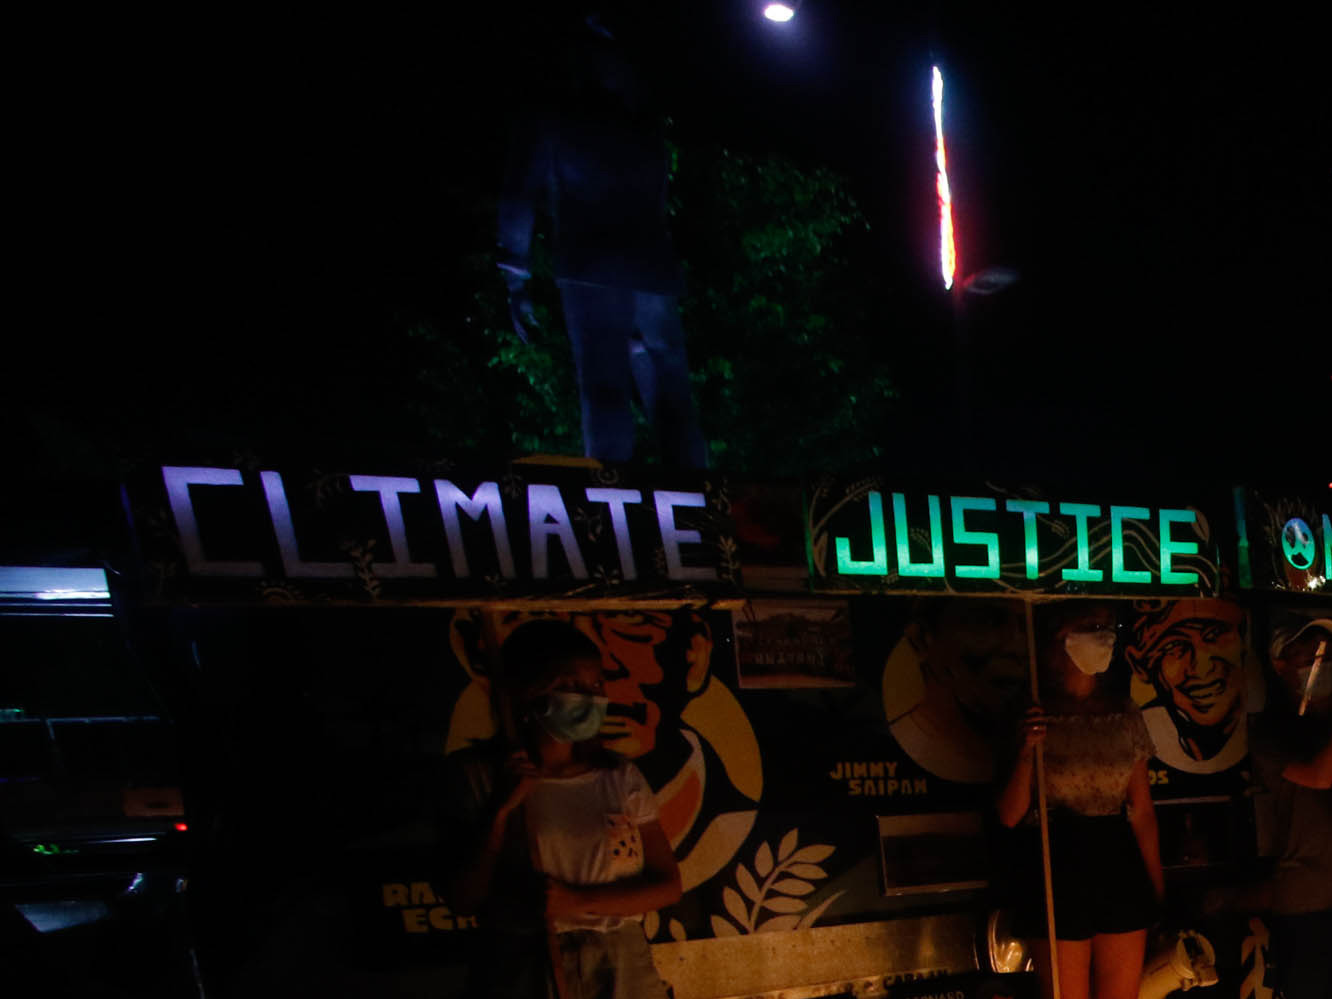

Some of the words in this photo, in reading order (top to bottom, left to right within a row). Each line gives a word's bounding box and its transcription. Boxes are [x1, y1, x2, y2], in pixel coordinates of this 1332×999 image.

[161, 465, 718, 582] CLIMATE
[836, 490, 1200, 584] JUSTICE
[830, 761, 898, 783] JIMMY
[848, 776, 928, 797] SAIPAN
